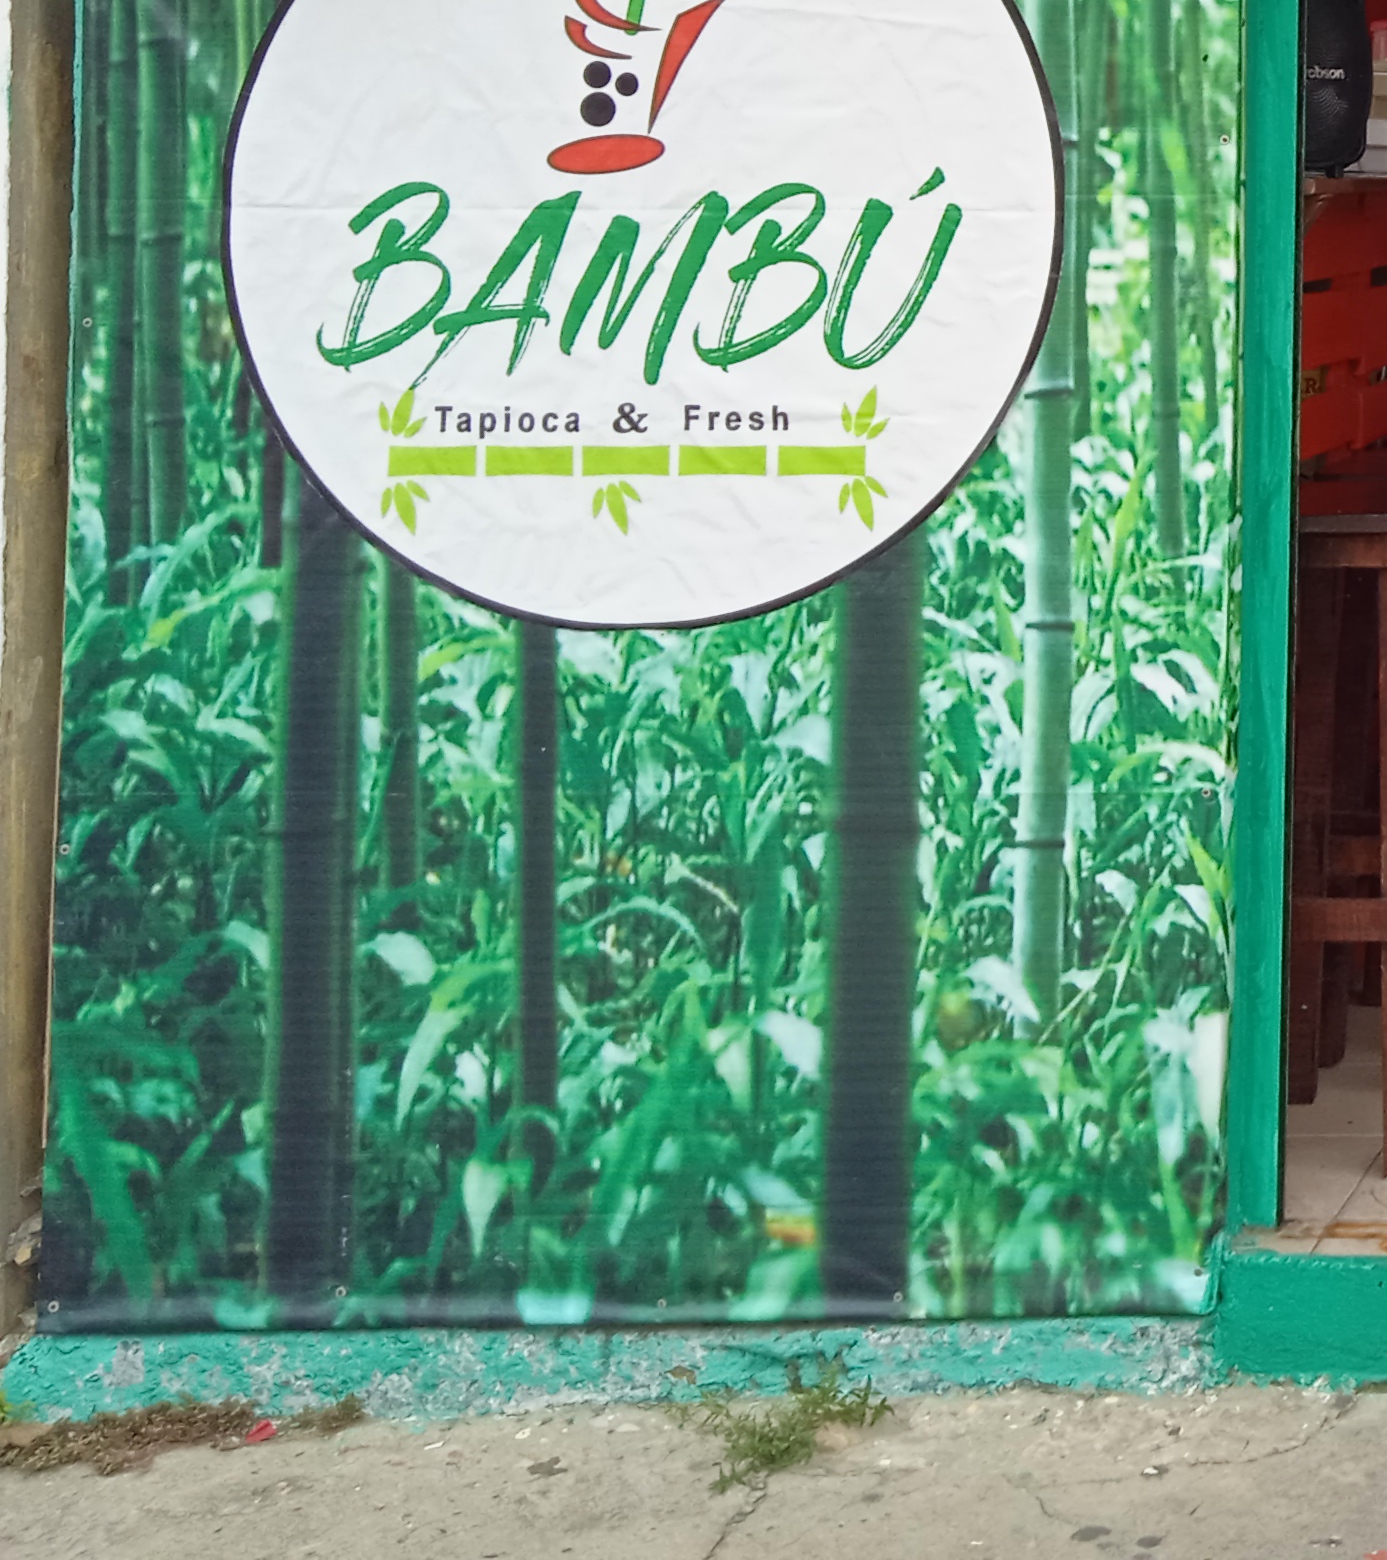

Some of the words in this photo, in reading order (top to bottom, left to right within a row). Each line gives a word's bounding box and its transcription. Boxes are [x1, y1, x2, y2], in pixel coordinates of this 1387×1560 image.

[316, 167, 963, 392] BAMBÚ
[434, 406, 581, 439] Tapioca
[612, 402, 649, 434] &
[684, 404, 790, 432] Fresh
